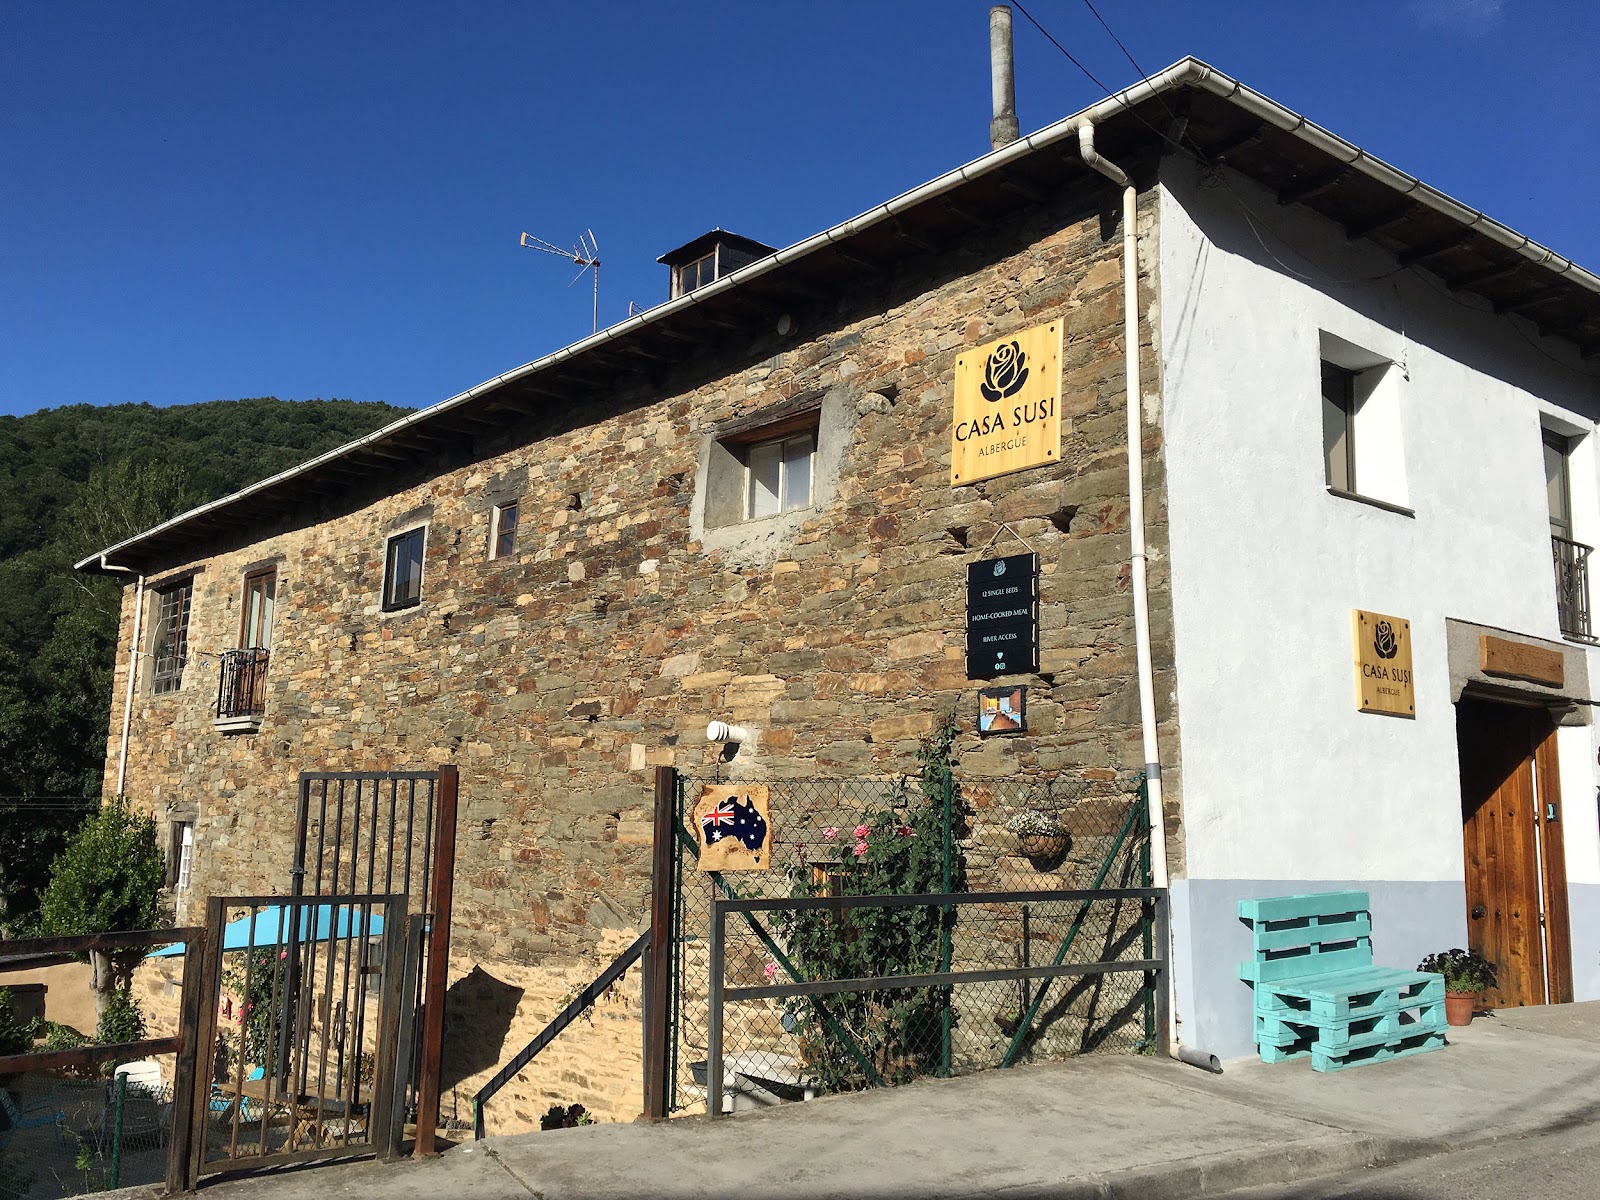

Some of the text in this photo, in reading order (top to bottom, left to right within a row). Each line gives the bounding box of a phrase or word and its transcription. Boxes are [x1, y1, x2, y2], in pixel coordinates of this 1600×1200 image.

[955, 397, 1055, 442] CASA SUSI
[978, 436, 1027, 457] ALBERGUE
[988, 588, 1005, 596] SINGLE
[1006, 586, 1018, 594] BEDS
[972, 608, 1028, 621] HOME-COOKED MEAL
[1363, 663, 1411, 684] CASA SUSI
[1376, 687, 1400, 696] ALBERGUE
